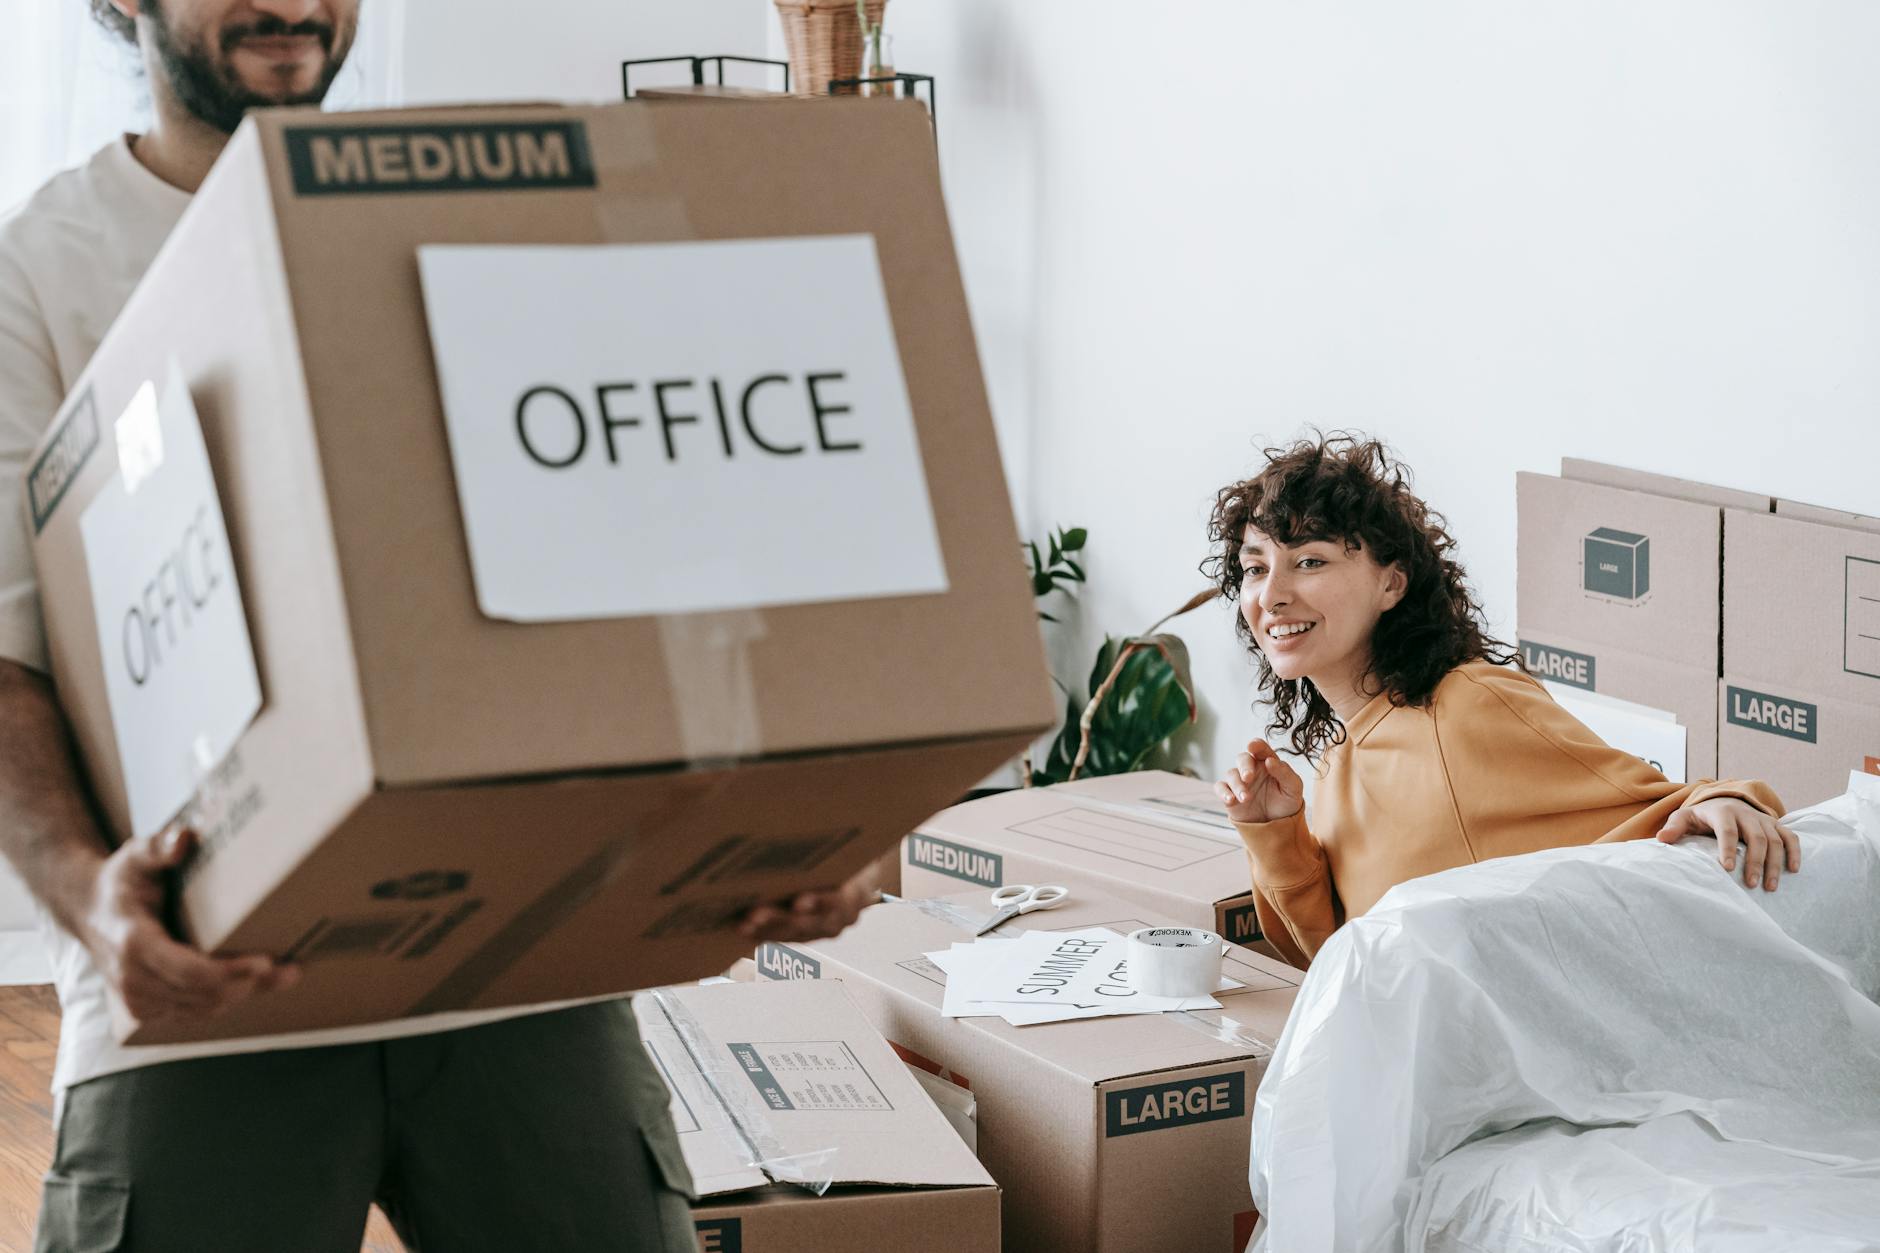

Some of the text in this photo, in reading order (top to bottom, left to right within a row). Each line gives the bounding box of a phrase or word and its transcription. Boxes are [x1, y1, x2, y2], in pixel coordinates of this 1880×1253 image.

[310, 131, 572, 184] MEDIUM
[515, 372, 862, 469] OFFICE
[122, 505, 221, 687] OFFICE
[1525, 647, 1588, 684] LARGE
[1735, 694, 1808, 734] LARGE
[914, 839, 996, 883] MEDIUM
[1016, 938, 1107, 995] SUMMER
[1120, 1081, 1231, 1127] LARGE
